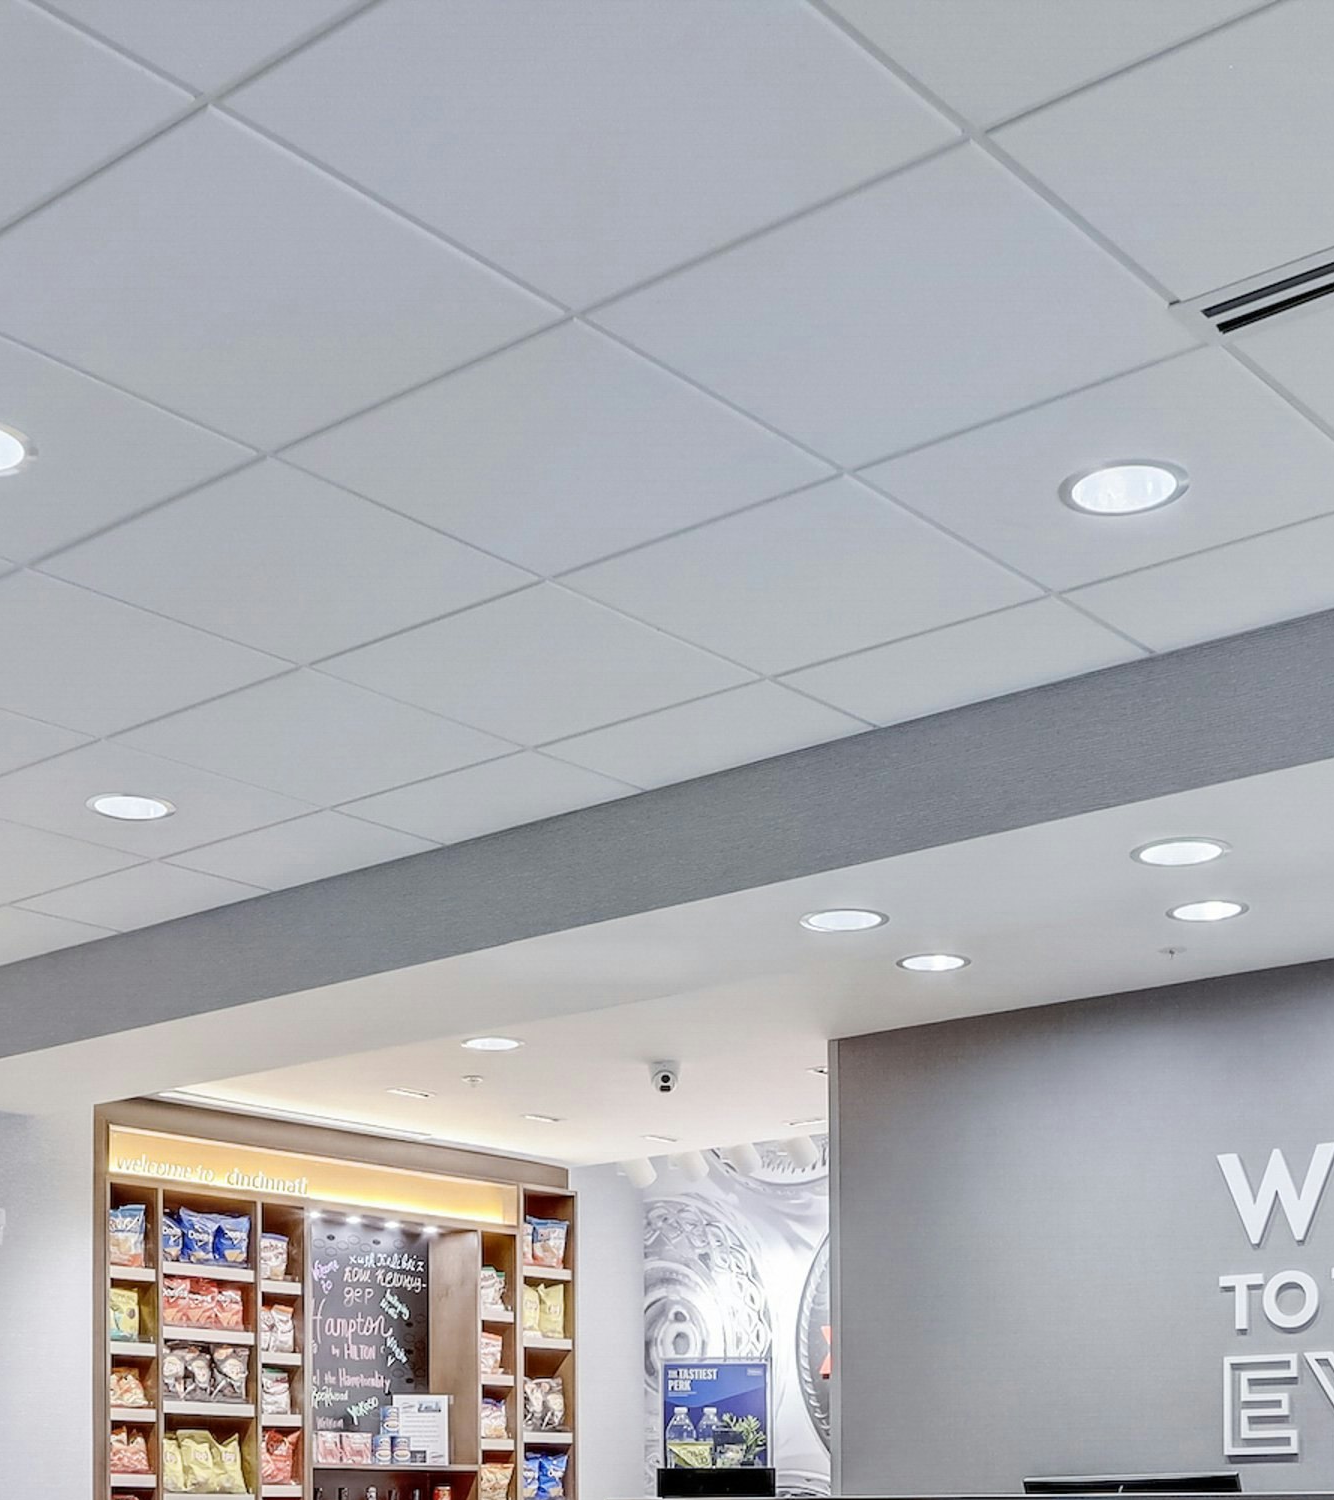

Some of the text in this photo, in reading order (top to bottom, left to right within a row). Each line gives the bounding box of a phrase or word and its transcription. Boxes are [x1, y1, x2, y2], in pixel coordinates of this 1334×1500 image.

[117, 1154, 308, 1195] welcome to cincinnati
[1218, 1272, 1320, 1330] TO
[344, 1343, 376, 1360] HILTON
[678, 1368, 718, 1380] TASTIEST
[668, 1380, 692, 1391] PERK
